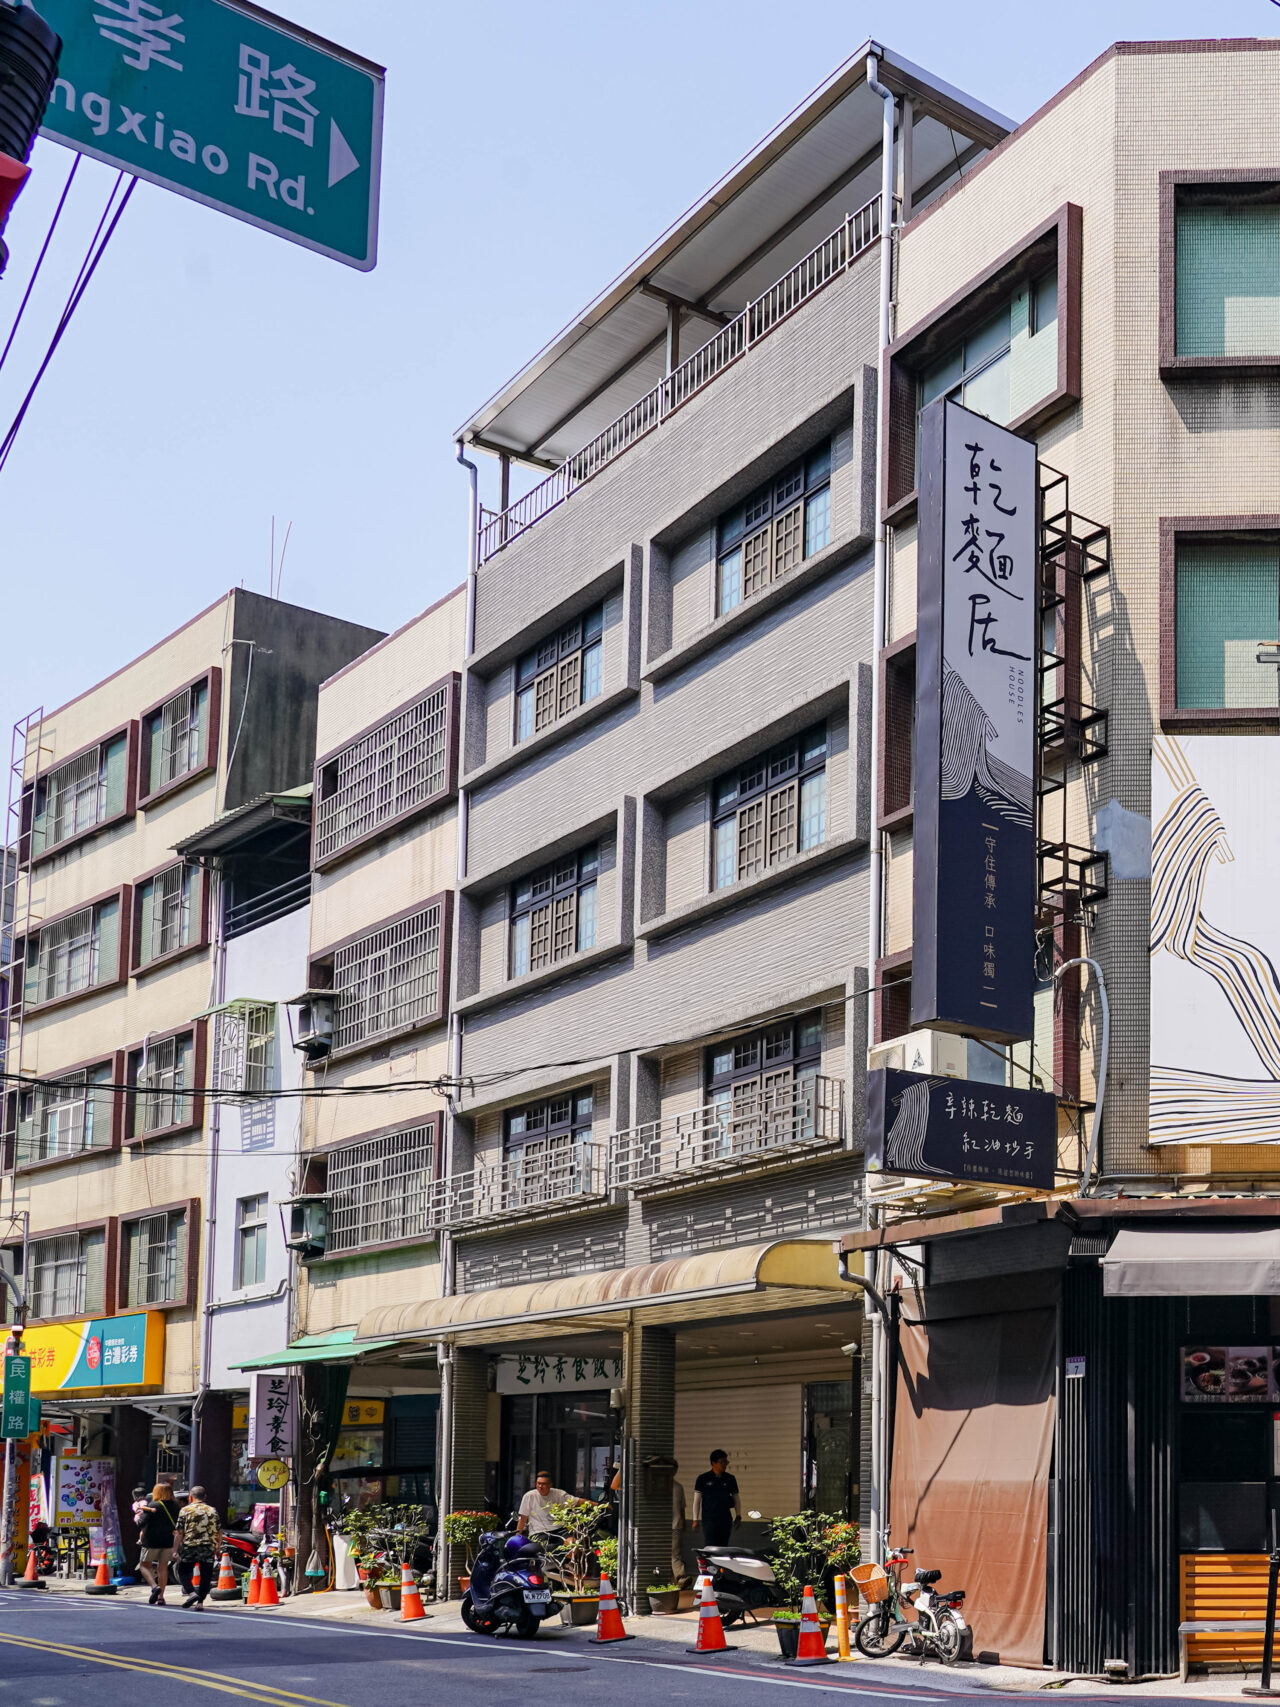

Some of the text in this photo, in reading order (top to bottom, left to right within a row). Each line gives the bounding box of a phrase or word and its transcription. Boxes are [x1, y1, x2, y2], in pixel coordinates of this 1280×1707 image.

[50, 77, 315, 216] ngxiao Rd.
[953, 442, 1031, 661] 乾麵居
[1008, 665, 1016, 706] HOUSE
[1016, 669, 1025, 725] NOODLES
[945, 1091, 1024, 1125] 辛辣乾麵
[104, 1345, 138, 1365] 台灣彩券
[7, 1364, 26, 1430] 民權路
[265, 1379, 291, 1453] 芝玲素食
